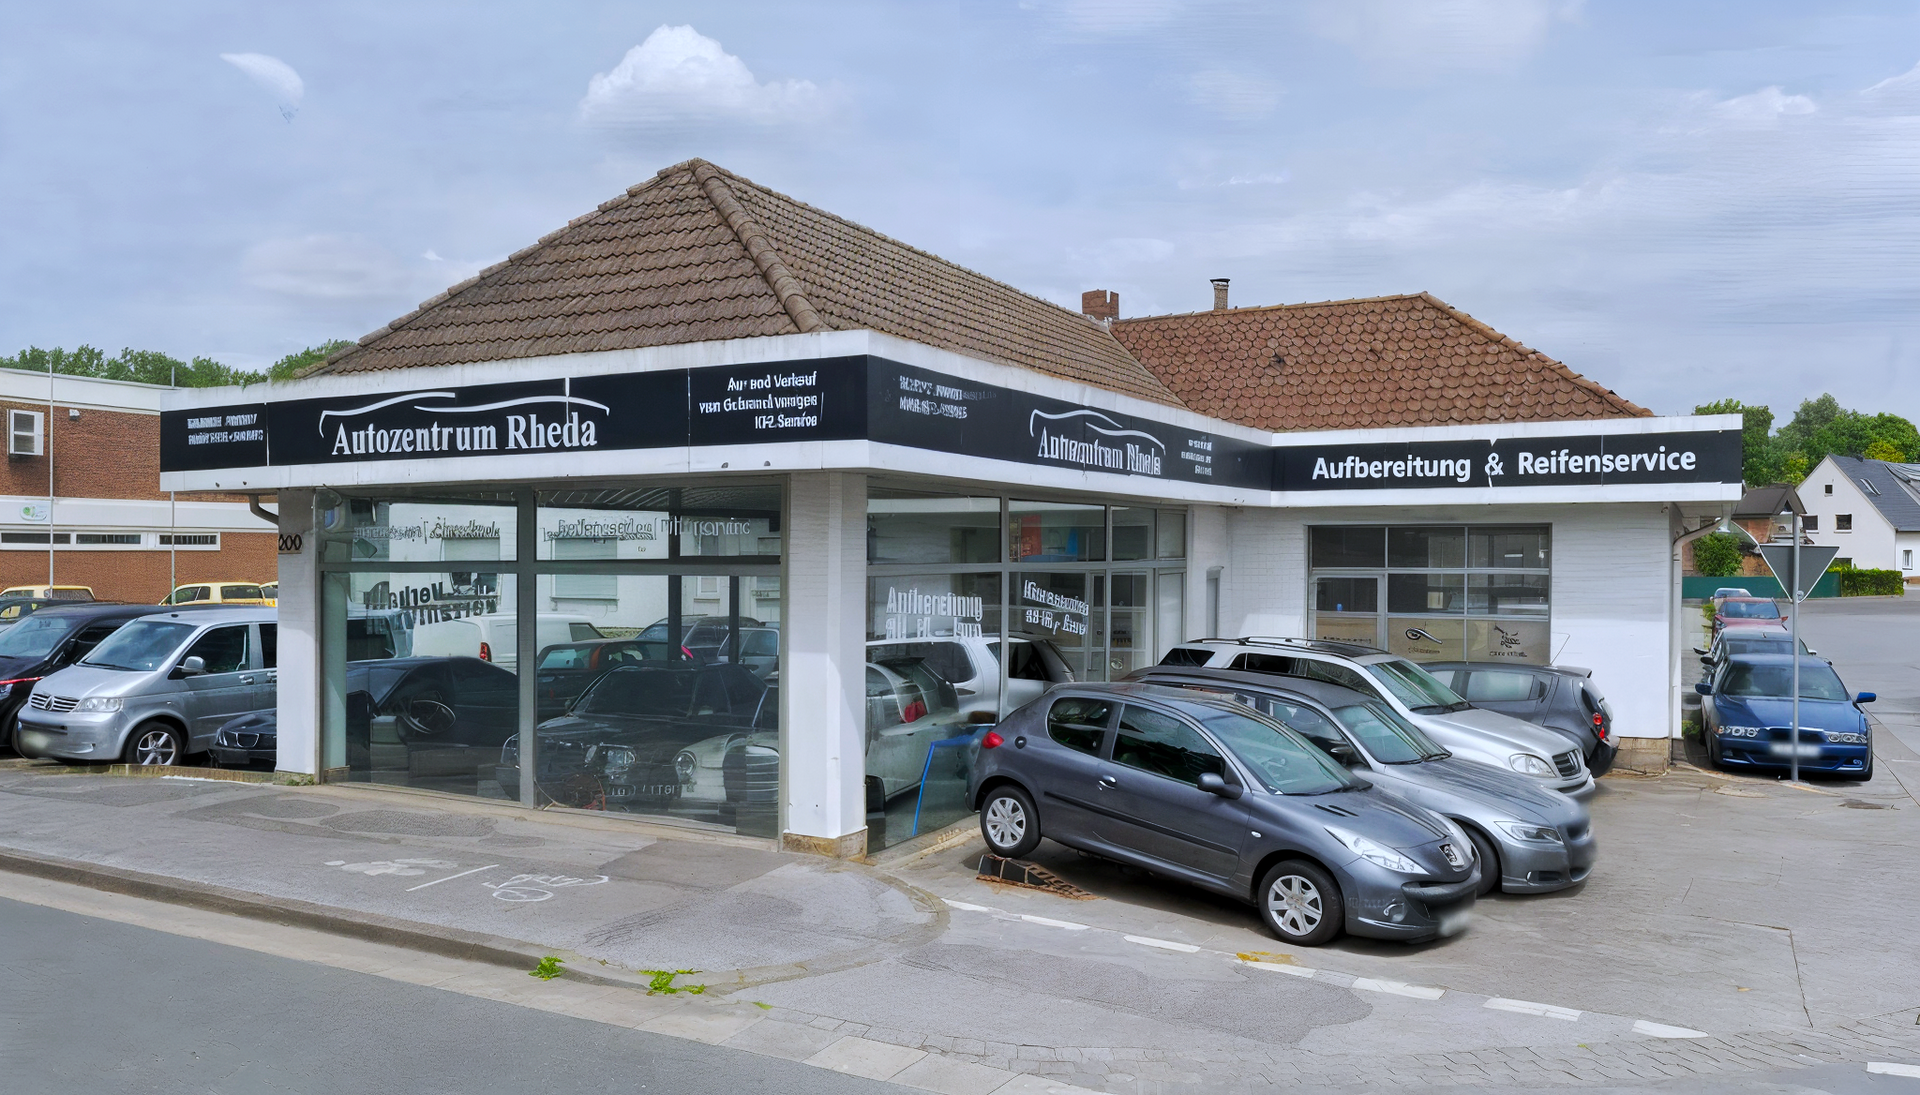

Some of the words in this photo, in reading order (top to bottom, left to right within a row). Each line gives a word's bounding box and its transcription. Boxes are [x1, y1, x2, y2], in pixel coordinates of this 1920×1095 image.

[331, 421, 498, 455] Autozentrum
[505, 411, 598, 450] Rheda
[1312, 454, 1471, 483] Aufbereitung
[1485, 452, 1504, 476] &
[1518, 446, 1697, 475] Reifenservice
